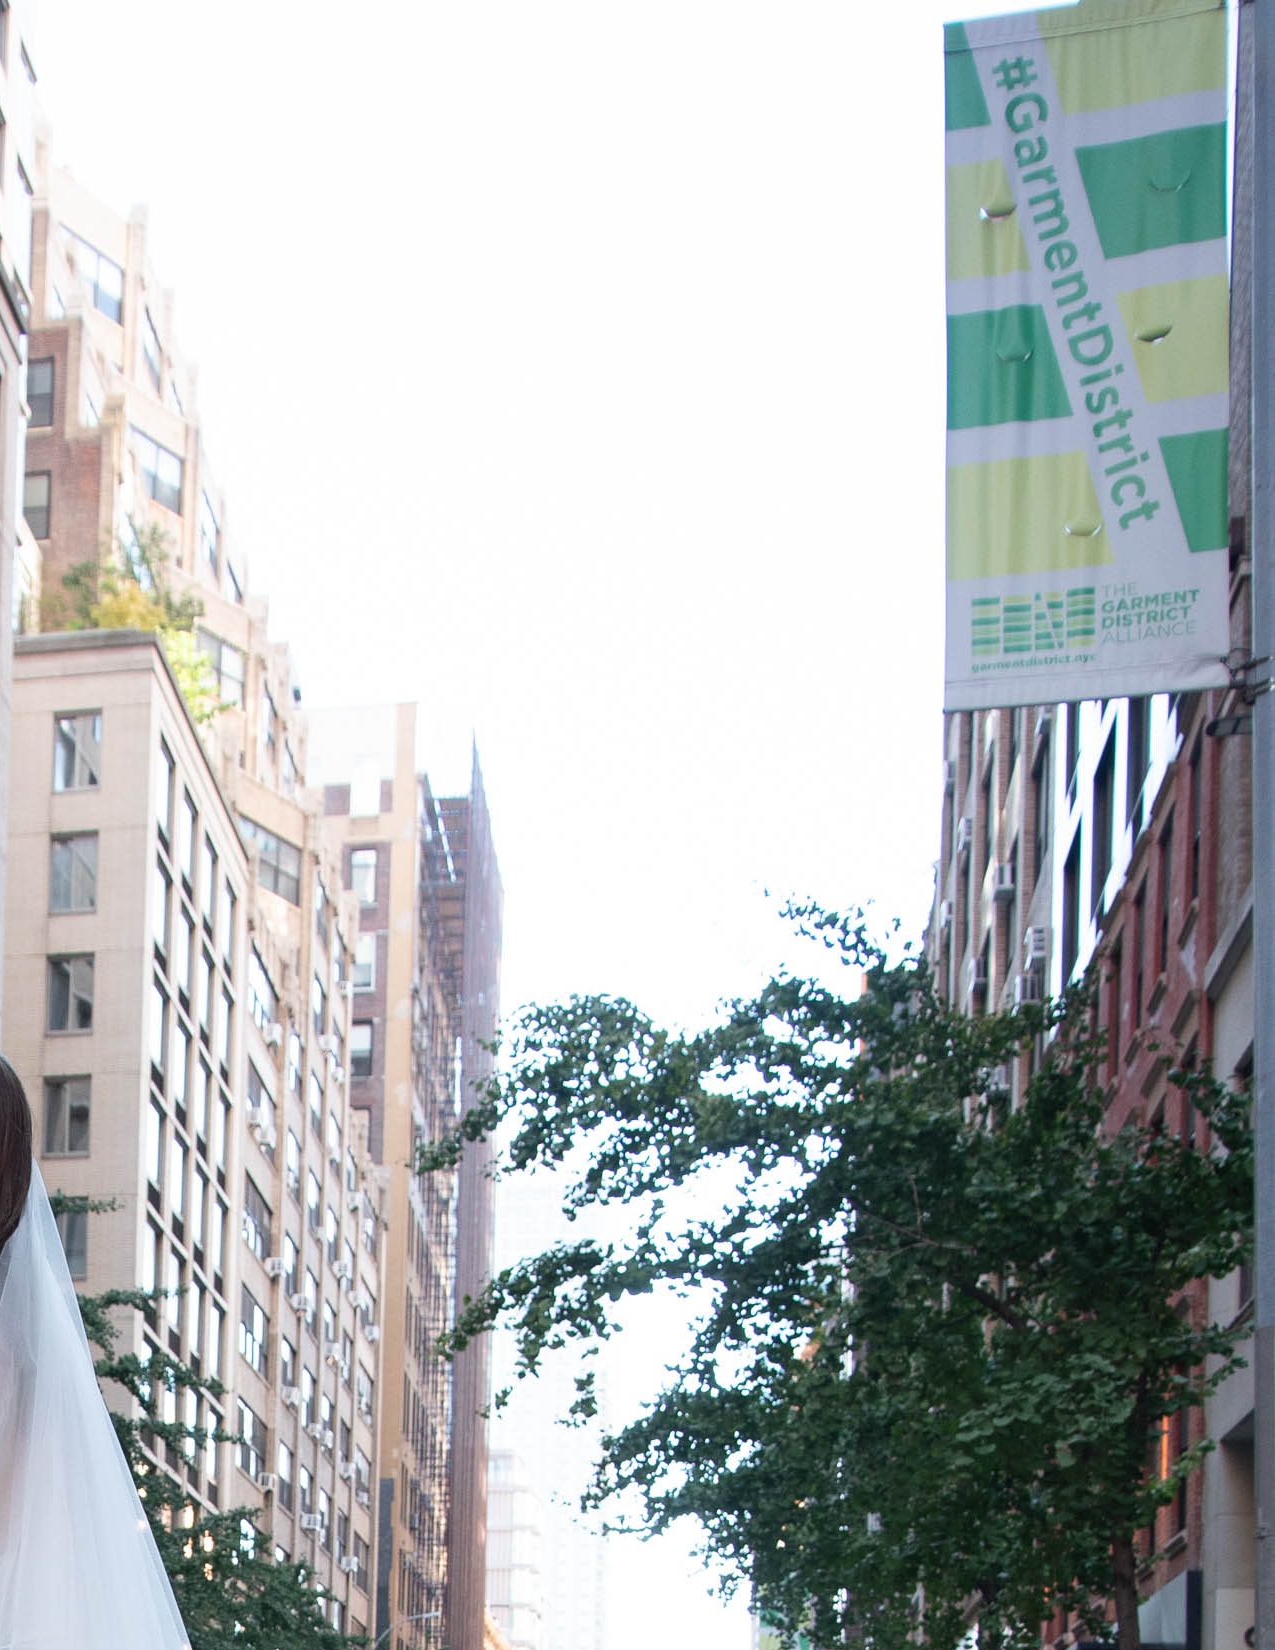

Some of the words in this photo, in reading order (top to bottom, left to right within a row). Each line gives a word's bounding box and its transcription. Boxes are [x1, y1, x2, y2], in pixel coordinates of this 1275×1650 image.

[992, 56, 1161, 530] #GarmentDistrict
[1101, 583, 1138, 598] THE
[1101, 589, 1201, 613] GARMENT
[1101, 605, 1192, 630] DISTRICT
[1101, 620, 1198, 646] ALLIANCE
[971, 653, 1096, 673] garmentdistrict.nyc
